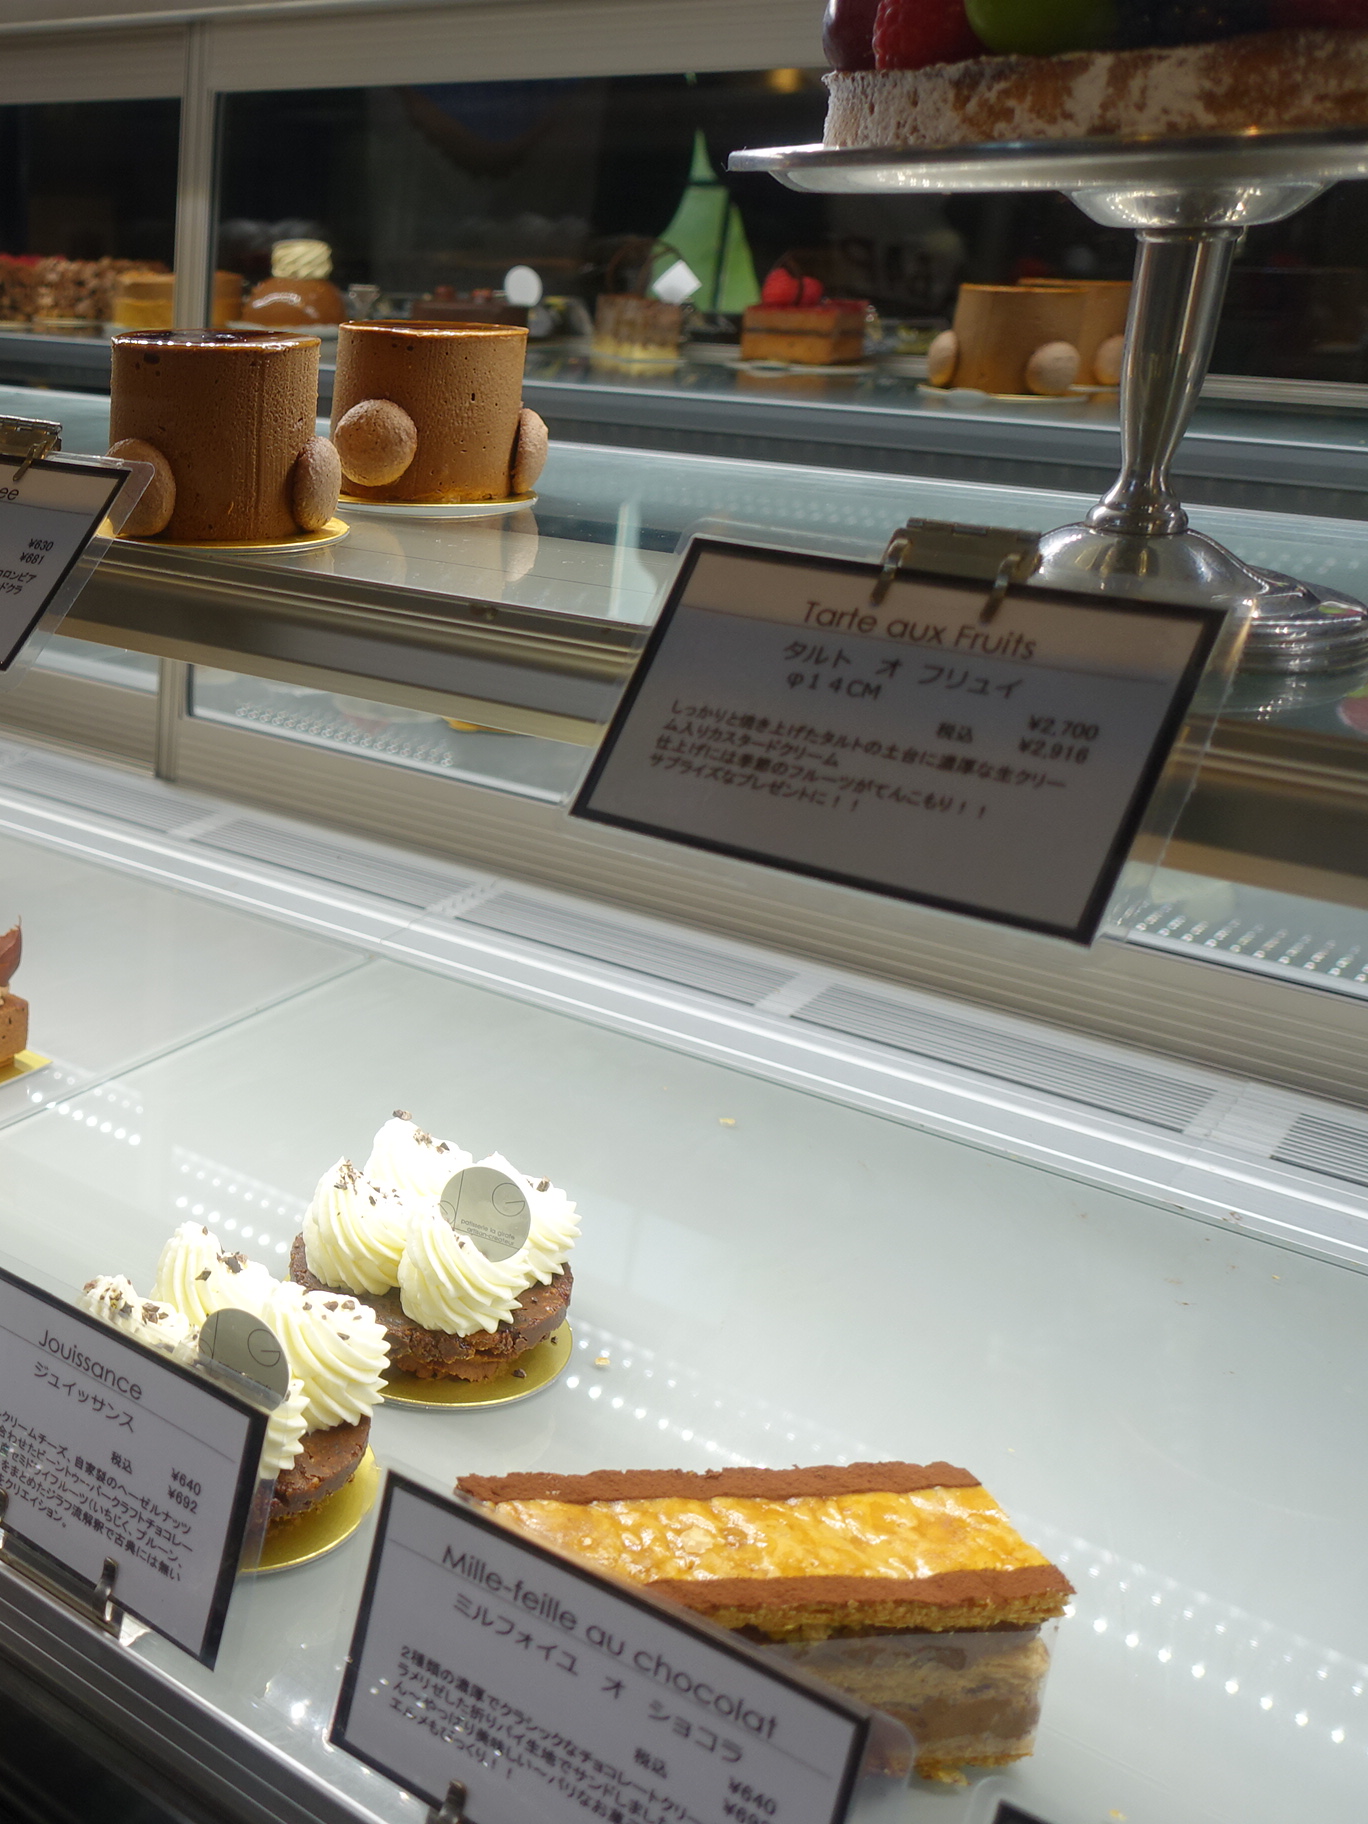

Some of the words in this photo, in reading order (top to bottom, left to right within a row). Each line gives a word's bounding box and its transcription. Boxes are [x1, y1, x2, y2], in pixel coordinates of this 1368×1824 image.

[19, 551, 45, 565] ¥681
[28, 538, 54, 552] ¥630
[803, 600, 878, 636] Tarte
[886, 619, 946, 646] aux
[950, 624, 1037, 663] Fruits
[783, 640, 851, 669] タルト
[875, 658, 902, 677] オ
[917, 663, 1023, 699] フリュイ
[662, 718, 839, 768] ム入りカスタードクリーム
[936, 722, 973, 743] 税込
[1018, 736, 1090, 764] ¥2,916
[1028, 714, 1100, 741] ¥2,700
[38, 1329, 142, 1400] Jouissance
[34, 1361, 134, 1433] ジュイッサンス
[110, 1451, 132, 1474] 税込
[167, 1485, 198, 1514] ¥692
[171, 1468, 201, 1496] ¥640
[442, 1545, 577, 1631] Mille-feille
[585, 1625, 625, 1657] au
[633, 1650, 778, 1740] chocolat
[454, 1593, 578, 1676] ミルフォイユ
[602, 1678, 624, 1699] オ
[648, 1700, 743, 1763] ショコラ
[634, 1748, 667, 1779] 税込
[728, 1779, 776, 1816] ¥640
